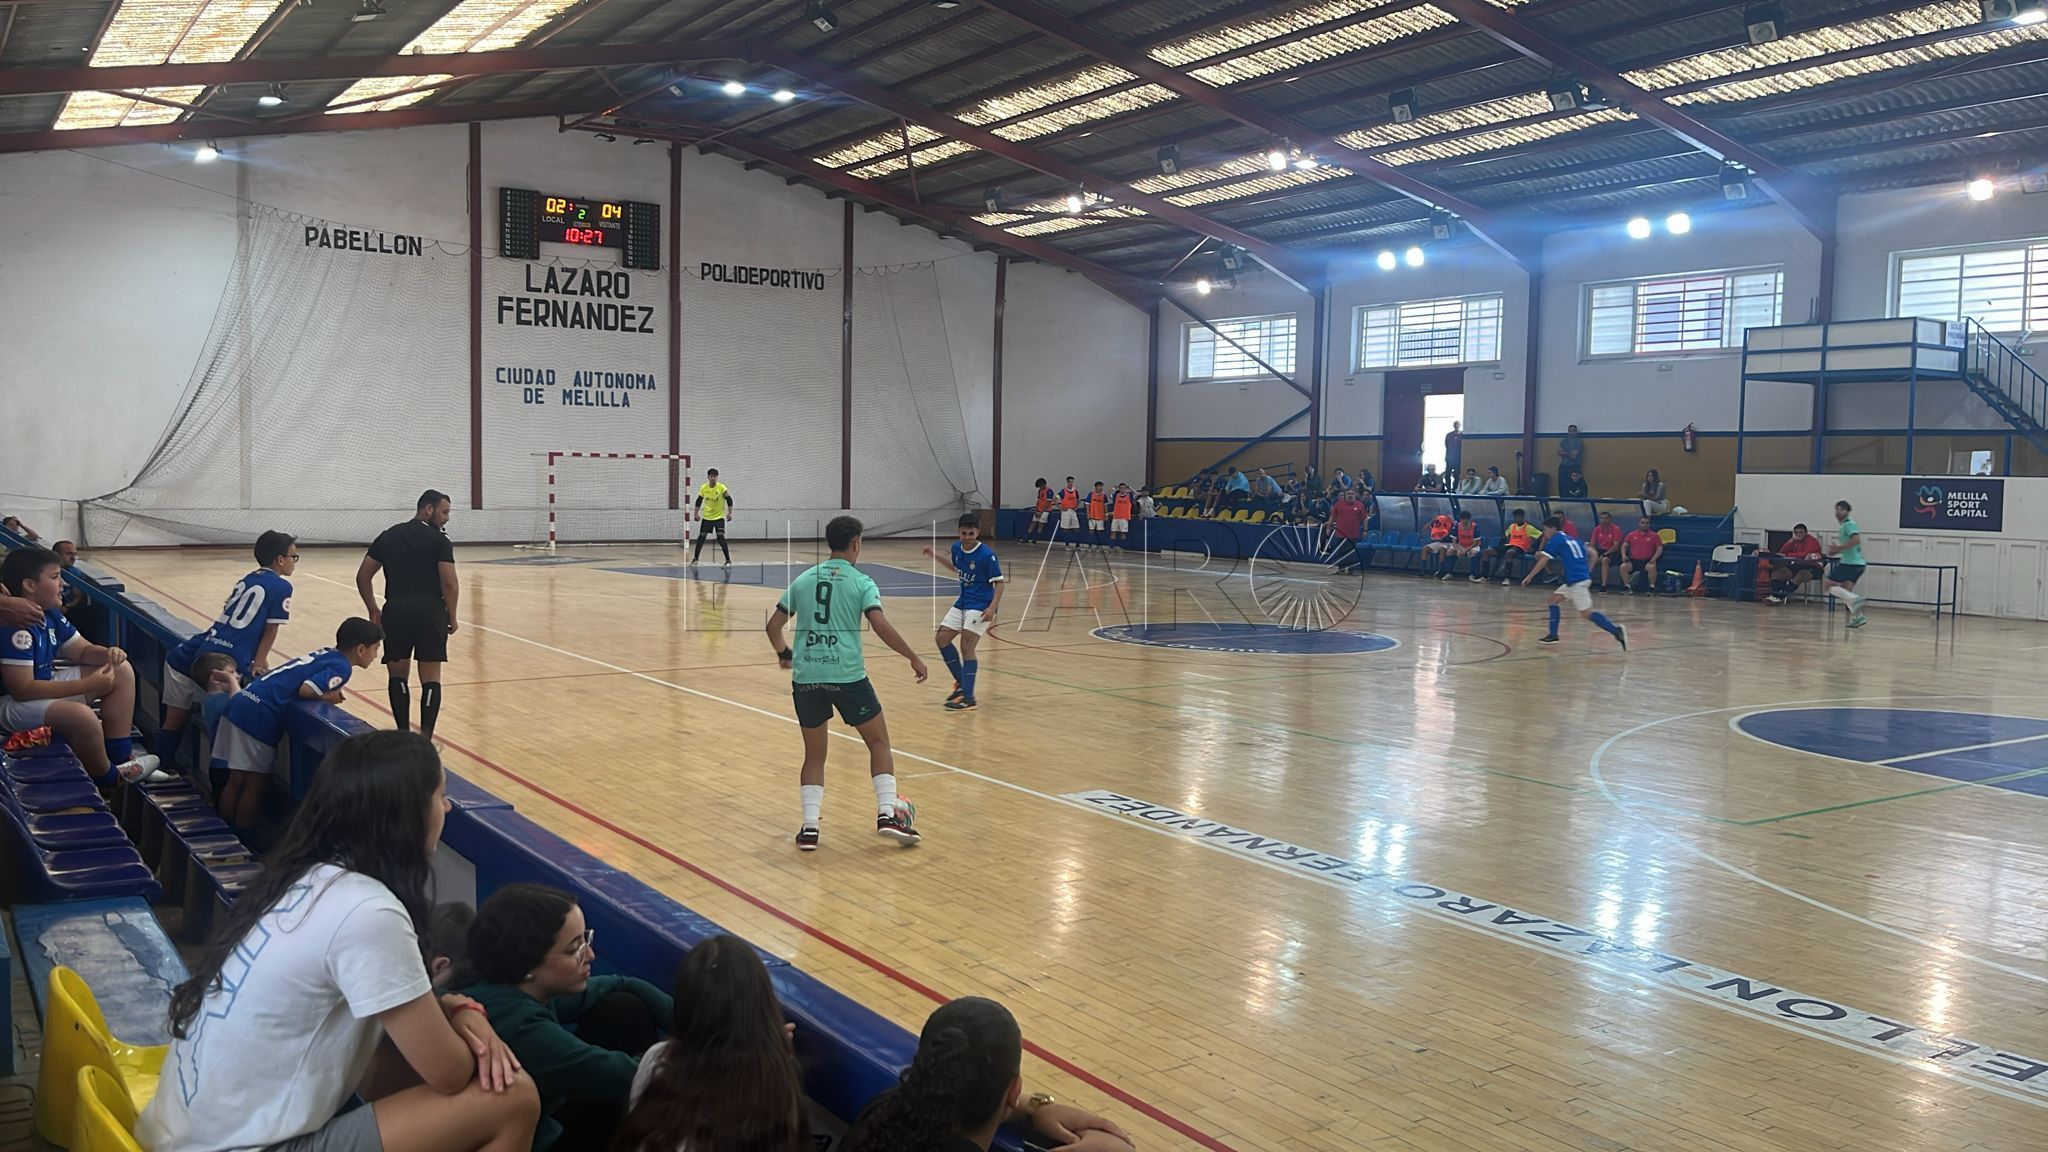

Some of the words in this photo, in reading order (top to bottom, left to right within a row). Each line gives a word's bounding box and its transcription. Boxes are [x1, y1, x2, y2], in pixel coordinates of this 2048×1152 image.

[578, 209, 586, 220] 2
[602, 203, 622, 219] 04
[542, 215, 565, 224] LOCAL
[599, 221, 621, 230] VISITANTE
[305, 226, 422, 256] PABELLON
[565, 228, 603, 244] 10:27
[526, 264, 630, 299] LAZARO
[701, 262, 824, 290] POLIDEPORTIVO
[498, 296, 654, 333] FERNANDEZ
[496, 367, 556, 385] CIUDAD
[573, 371, 656, 390] AUTONOMA
[523, 388, 545, 404] DE
[562, 389, 630, 408] MELILLA
[1947, 491, 1989, 501] MELILLA
[1947, 500, 1981, 509] SPORT
[1946, 508, 1988, 518] CAPITAL
[1566, 540, 1584, 558] 11
[215, 581, 266, 629] 20
[814, 581, 833, 624] 9
